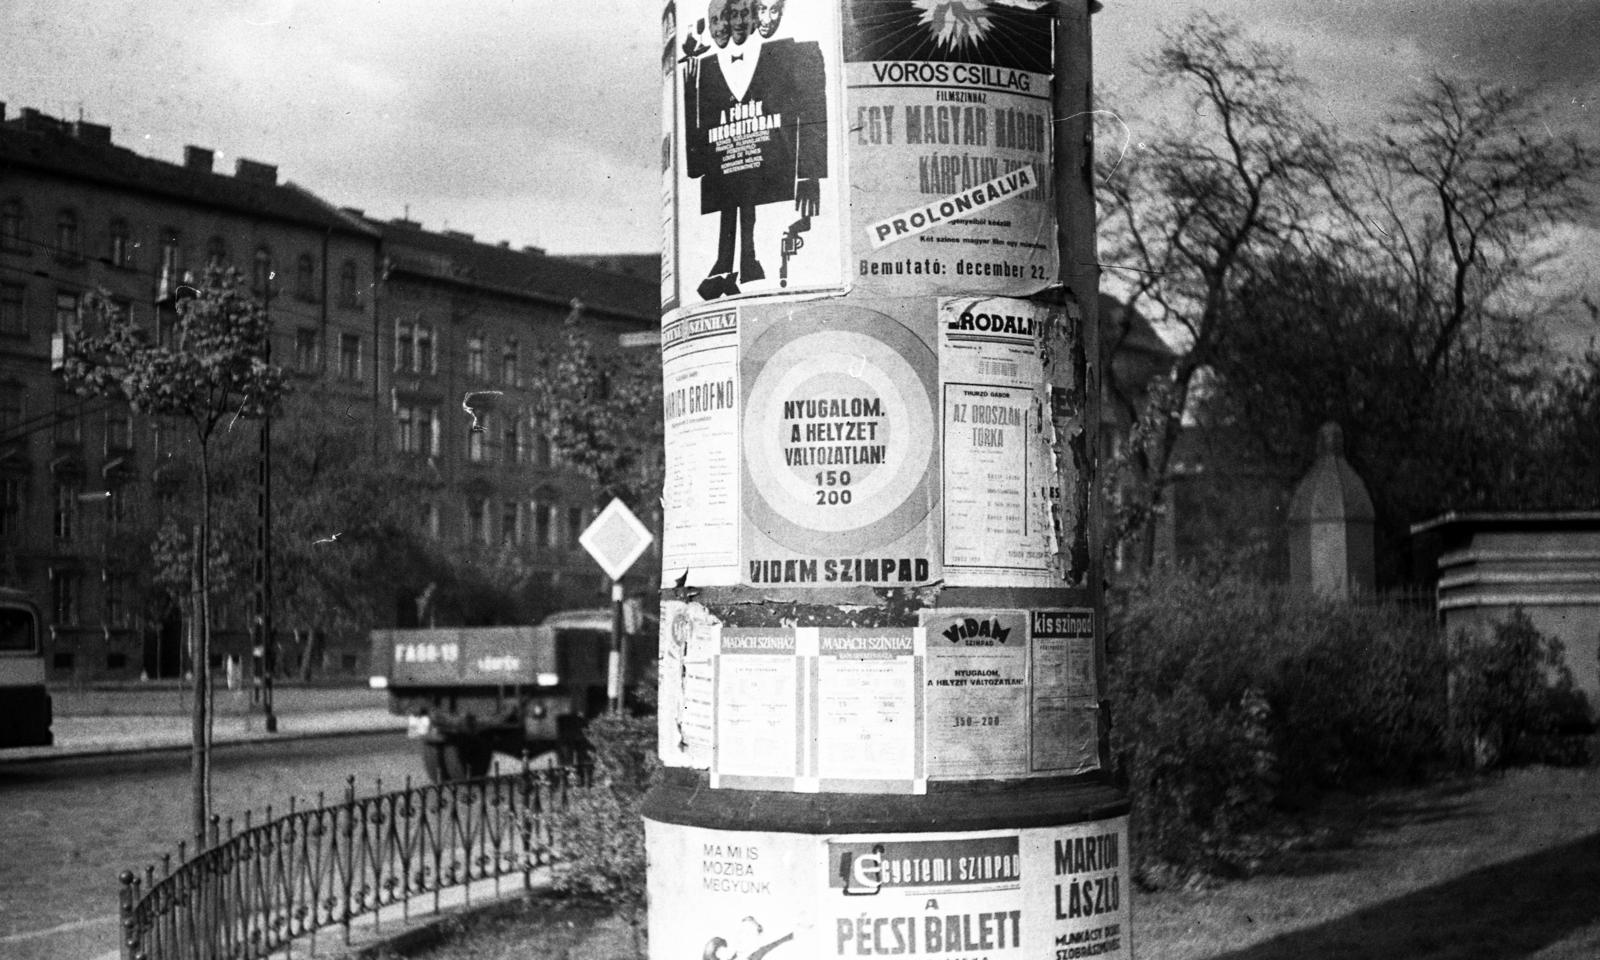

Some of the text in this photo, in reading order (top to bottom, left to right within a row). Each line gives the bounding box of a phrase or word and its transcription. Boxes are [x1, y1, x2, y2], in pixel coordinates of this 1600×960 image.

[953, 65, 1030, 92] CSILLAG
[857, 105, 895, 145] EGY
[905, 104, 988, 147] MAGYAR
[860, 258, 1050, 281] Bemutató: december 22.
[953, 404, 968, 423] AZ
[791, 421, 878, 443] A HELYZET
[815, 471, 851, 486] 150
[816, 490, 852, 505] 200
[824, 558, 929, 582] SZINPAD
[1035, 611, 1053, 633] kis
[703, 843, 722, 857] MA
[746, 847, 759, 860] IS
[925, 899, 939, 910] A
[1055, 871, 1119, 920] LÁSZLÓ
[837, 909, 1021, 955] PÉCSI BALETT
